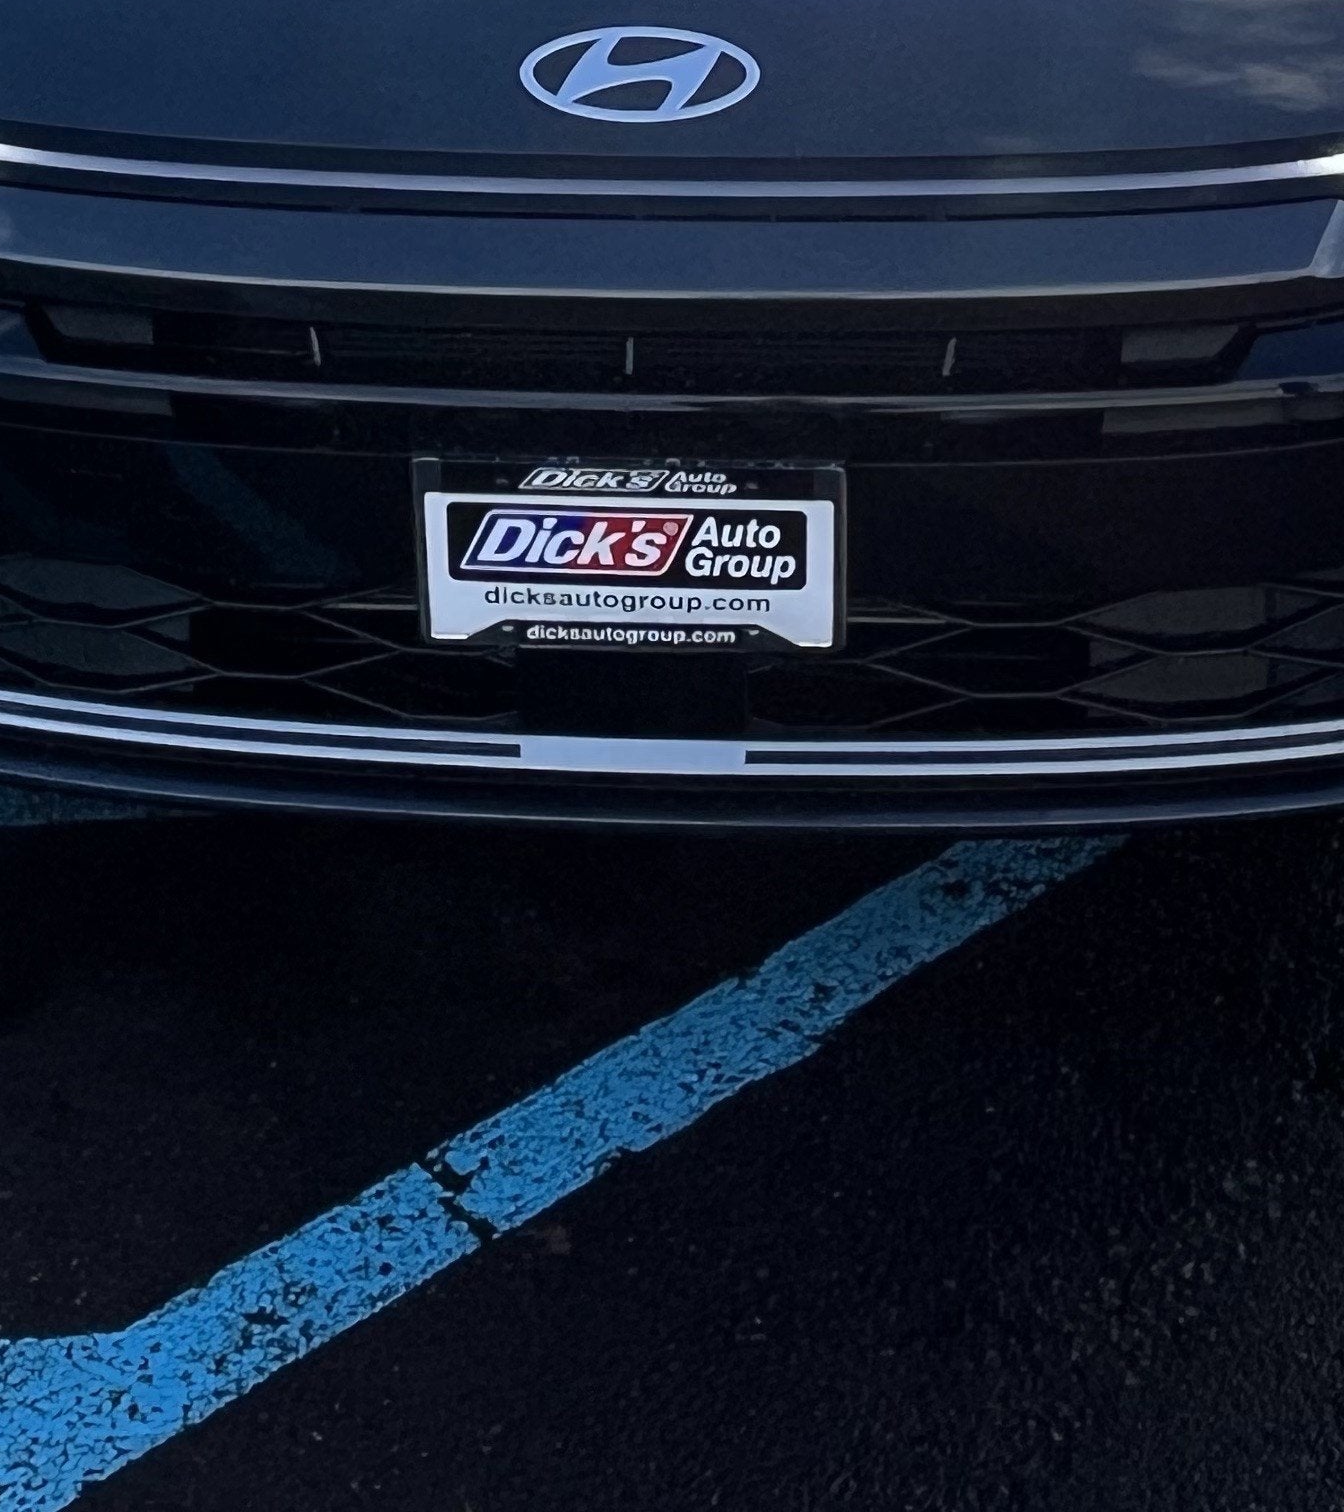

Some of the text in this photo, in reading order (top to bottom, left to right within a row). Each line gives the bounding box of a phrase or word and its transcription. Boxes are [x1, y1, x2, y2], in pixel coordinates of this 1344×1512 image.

[530, 469, 654, 489] Dick's
[664, 480, 738, 495] Group
[670, 471, 727, 484] Auto
[477, 516, 667, 567] Dick's
[691, 516, 781, 549] Auto
[684, 546, 796, 585] Group
[484, 586, 771, 614] dicksautogroup.com
[526, 624, 736, 645] dicksautogroup.com
